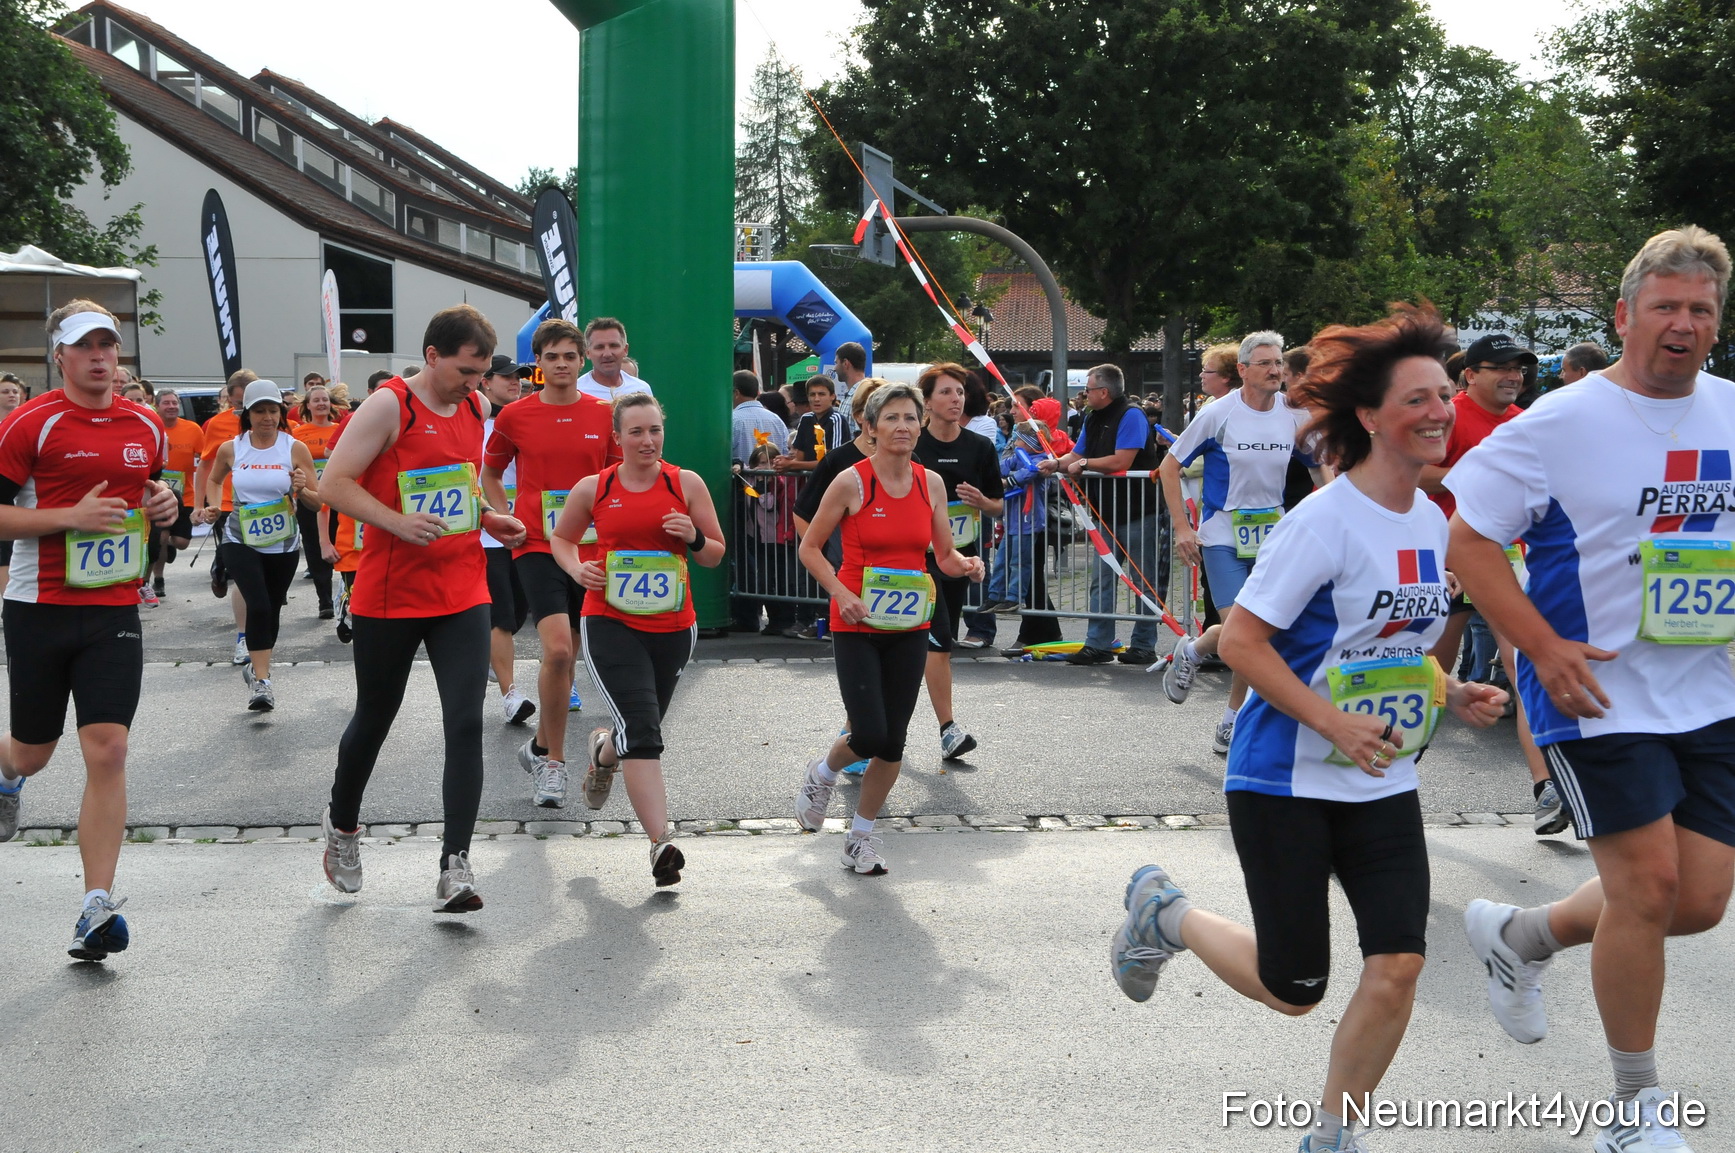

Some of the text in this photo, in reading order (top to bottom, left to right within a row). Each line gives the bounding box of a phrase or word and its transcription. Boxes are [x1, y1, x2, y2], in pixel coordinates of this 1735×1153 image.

[1237, 443, 1291, 452] DELPHI
[1660, 482, 1732, 495] AUTOHAUS
[410, 488, 463, 518] 742
[248, 513, 286, 537] 489
[76, 535, 131, 571] 761
[86, 568, 115, 577] Michael
[615, 572, 670, 598] 743
[1394, 585, 1443, 599] AUTOHAUS
[625, 598, 644, 607] Sonja
[870, 588, 919, 616] 722
[1649, 577, 1735, 615] 1252
[1664, 618, 1699, 629] Herbert
